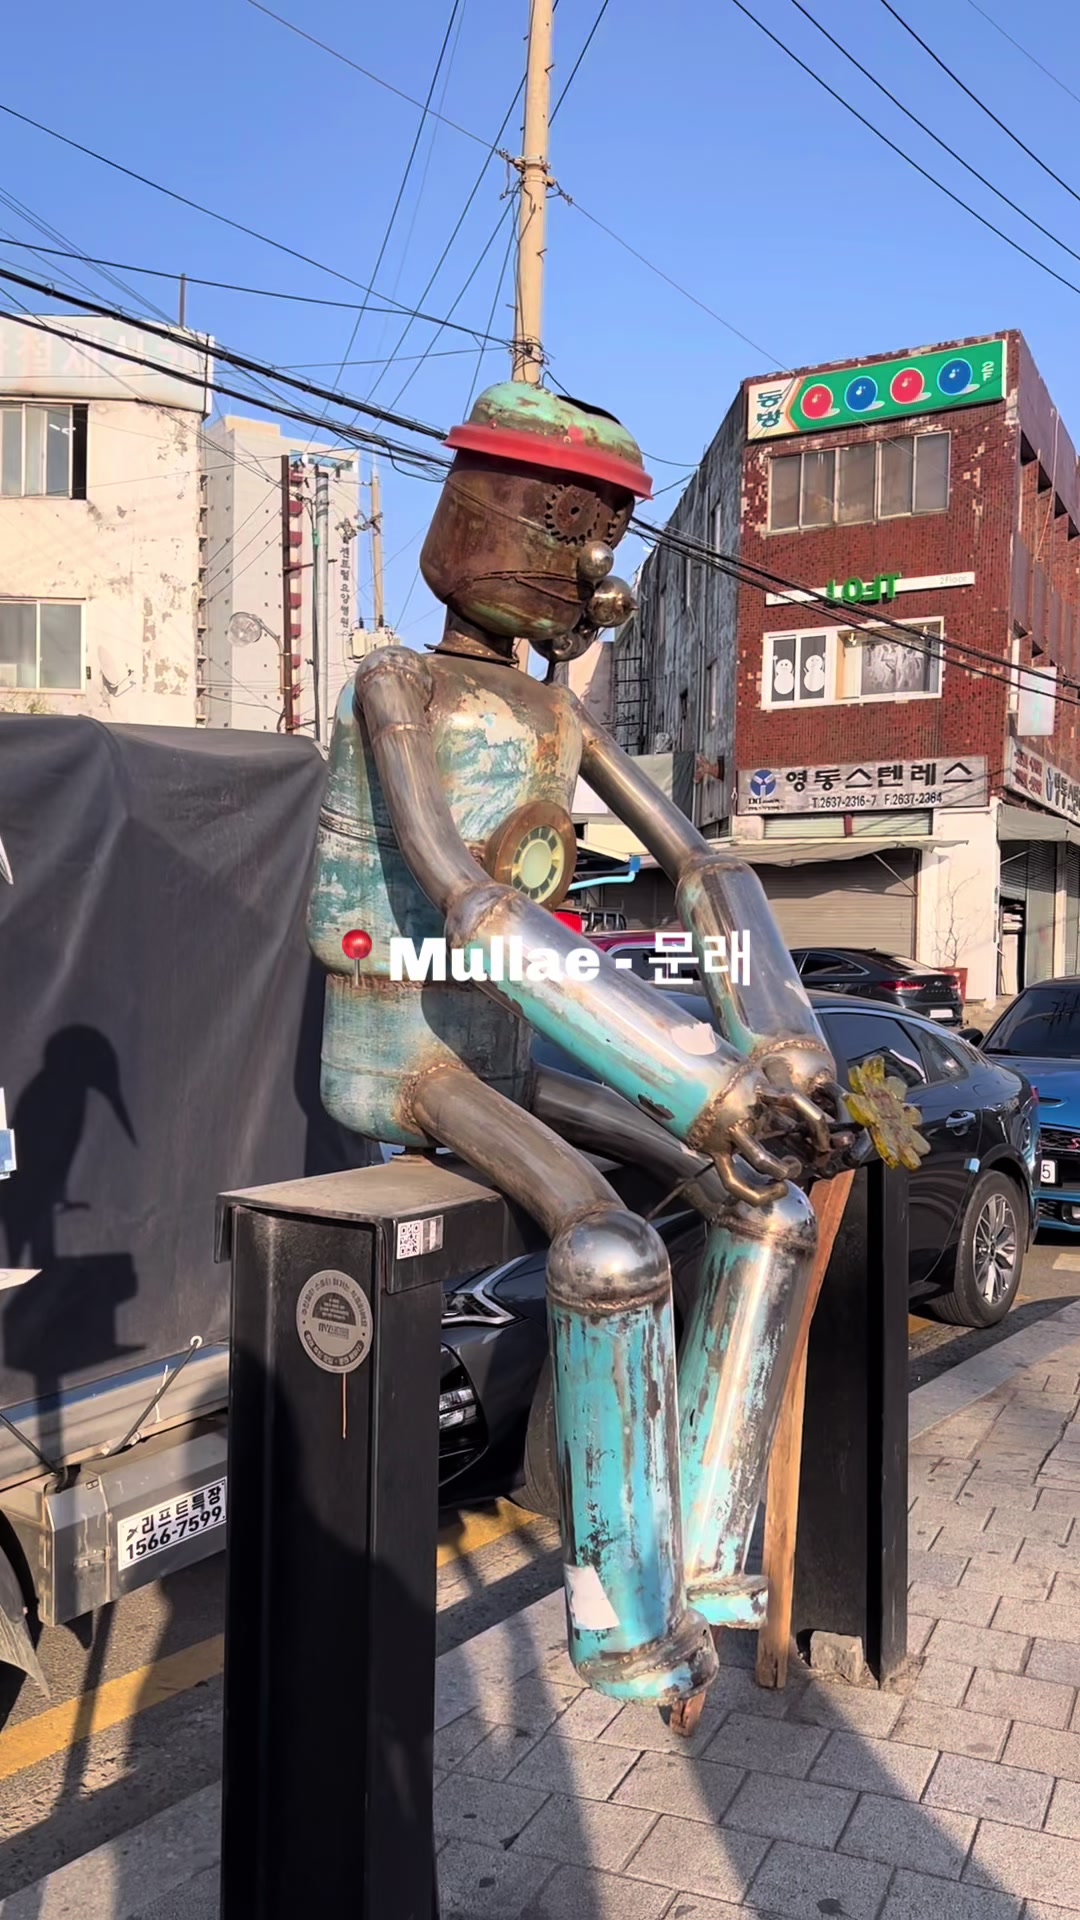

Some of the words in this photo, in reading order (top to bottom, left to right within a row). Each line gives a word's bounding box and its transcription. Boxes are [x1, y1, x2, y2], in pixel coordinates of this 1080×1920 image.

[981, 361, 995, 381] 2F
[786, 762, 974, 793] 영동스텐레스
[141, 1485, 222, 1535] 리프트특장
[126, 1506, 222, 1560] 1566-7599
